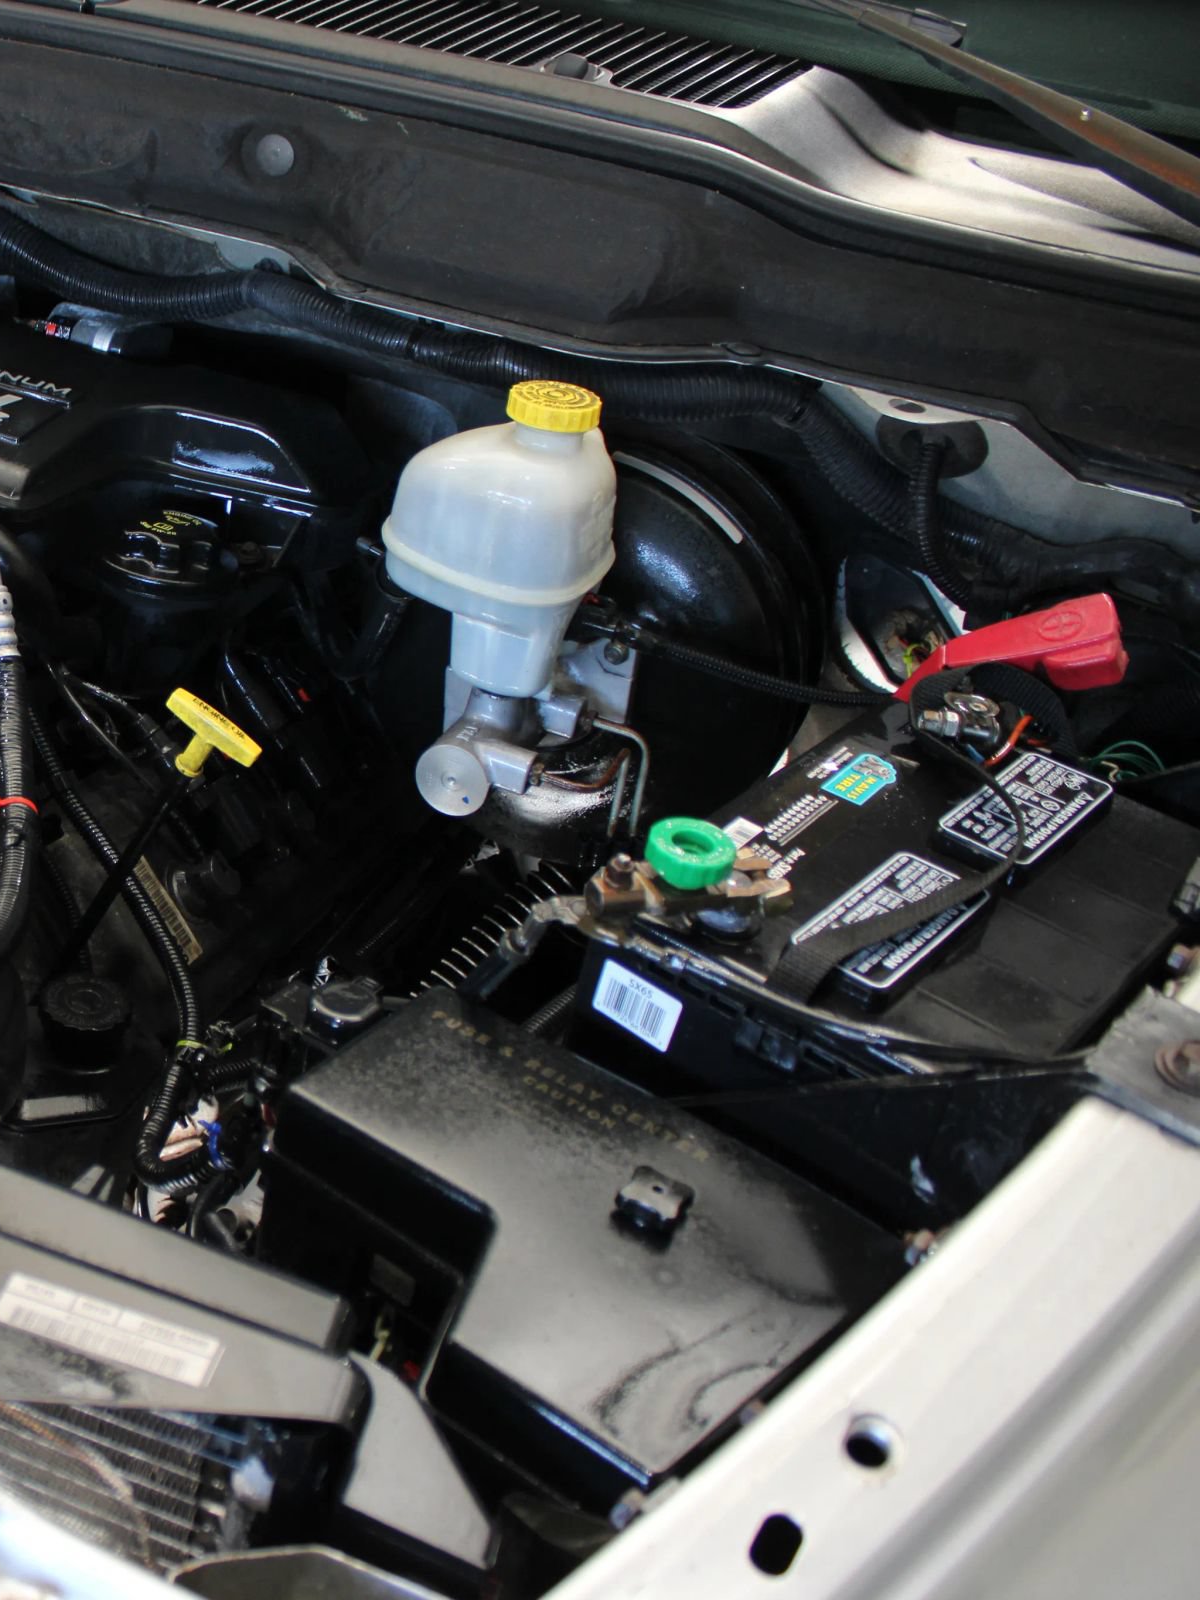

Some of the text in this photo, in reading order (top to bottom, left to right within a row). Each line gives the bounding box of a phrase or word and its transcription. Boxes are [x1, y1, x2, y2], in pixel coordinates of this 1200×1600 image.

[834, 773, 861, 792] TIRE
[846, 776, 877, 800] MAVIS
[628, 979, 654, 1000] SX65
[431, 1009, 491, 1046] FUSE
[524, 1058, 604, 1101] RELAY
[611, 1103, 710, 1162] CENTER
[522, 1075, 617, 1130] CAUTION
